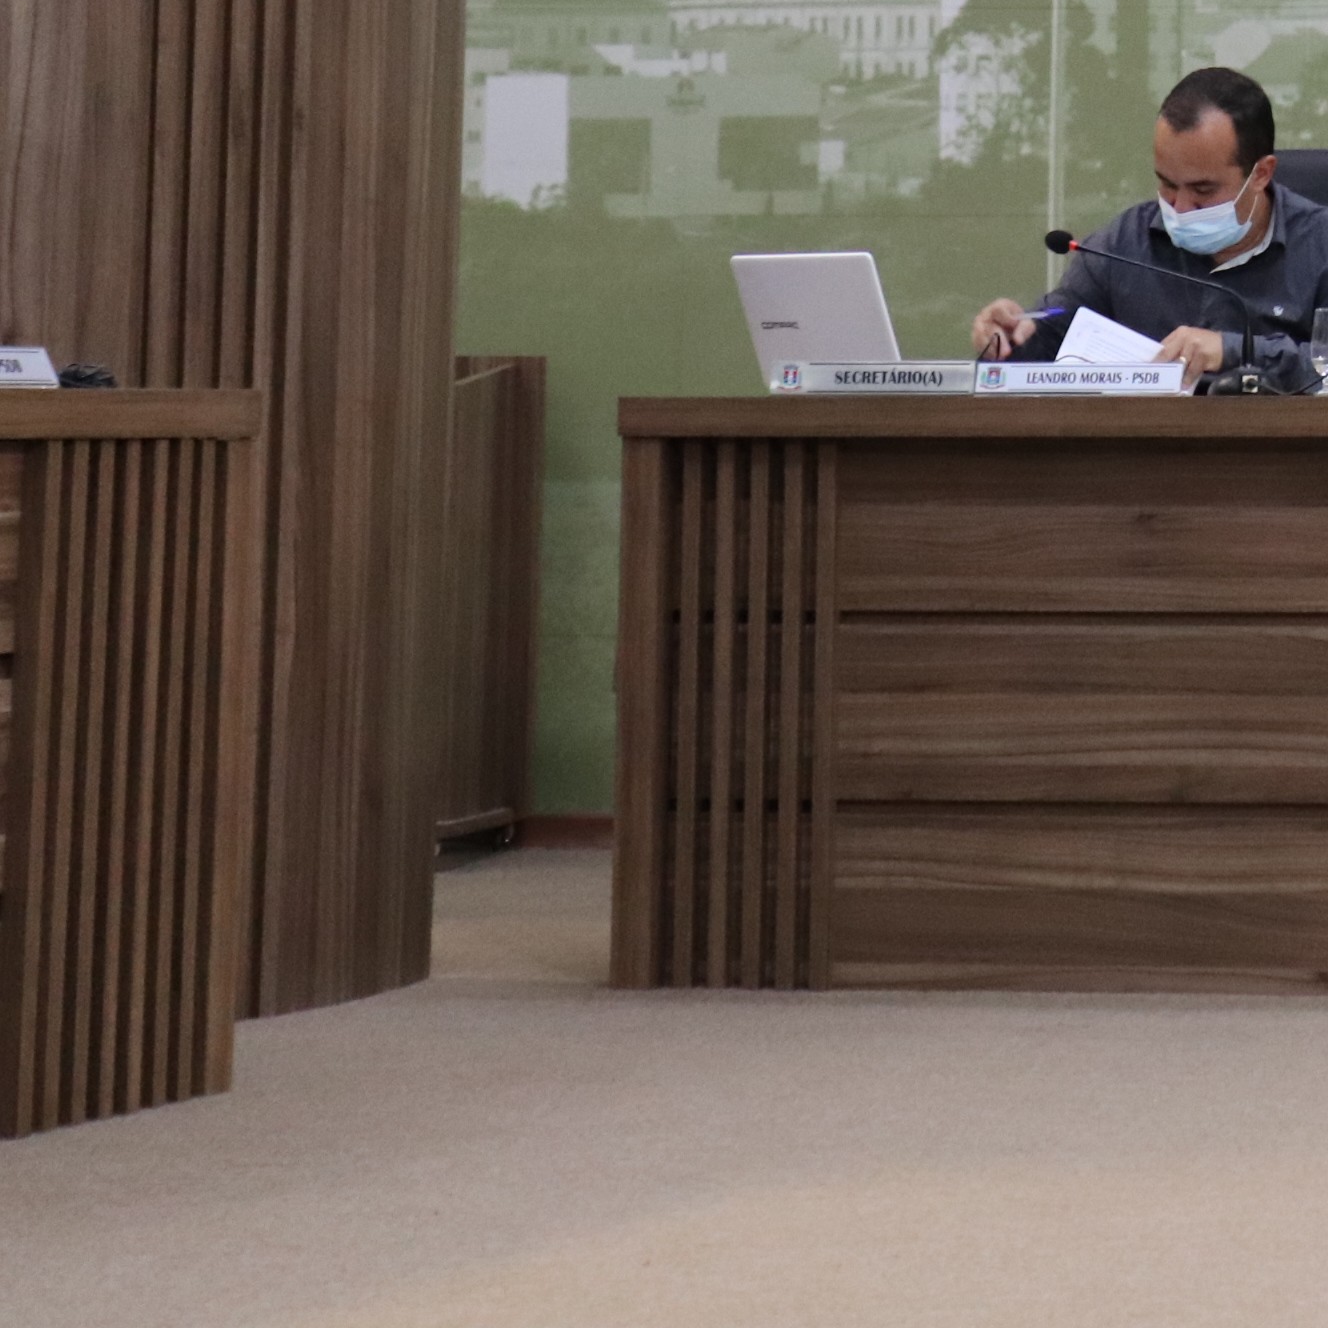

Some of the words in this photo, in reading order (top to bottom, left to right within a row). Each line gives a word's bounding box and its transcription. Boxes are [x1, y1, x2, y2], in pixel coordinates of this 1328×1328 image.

[834, 368, 944, 386] SECRETÁRIO(A)
[1026, 372, 1076, 384] LEANDRO
[1079, 372, 1122, 384] MORAIS
[1132, 372, 1160, 384] PSDB
